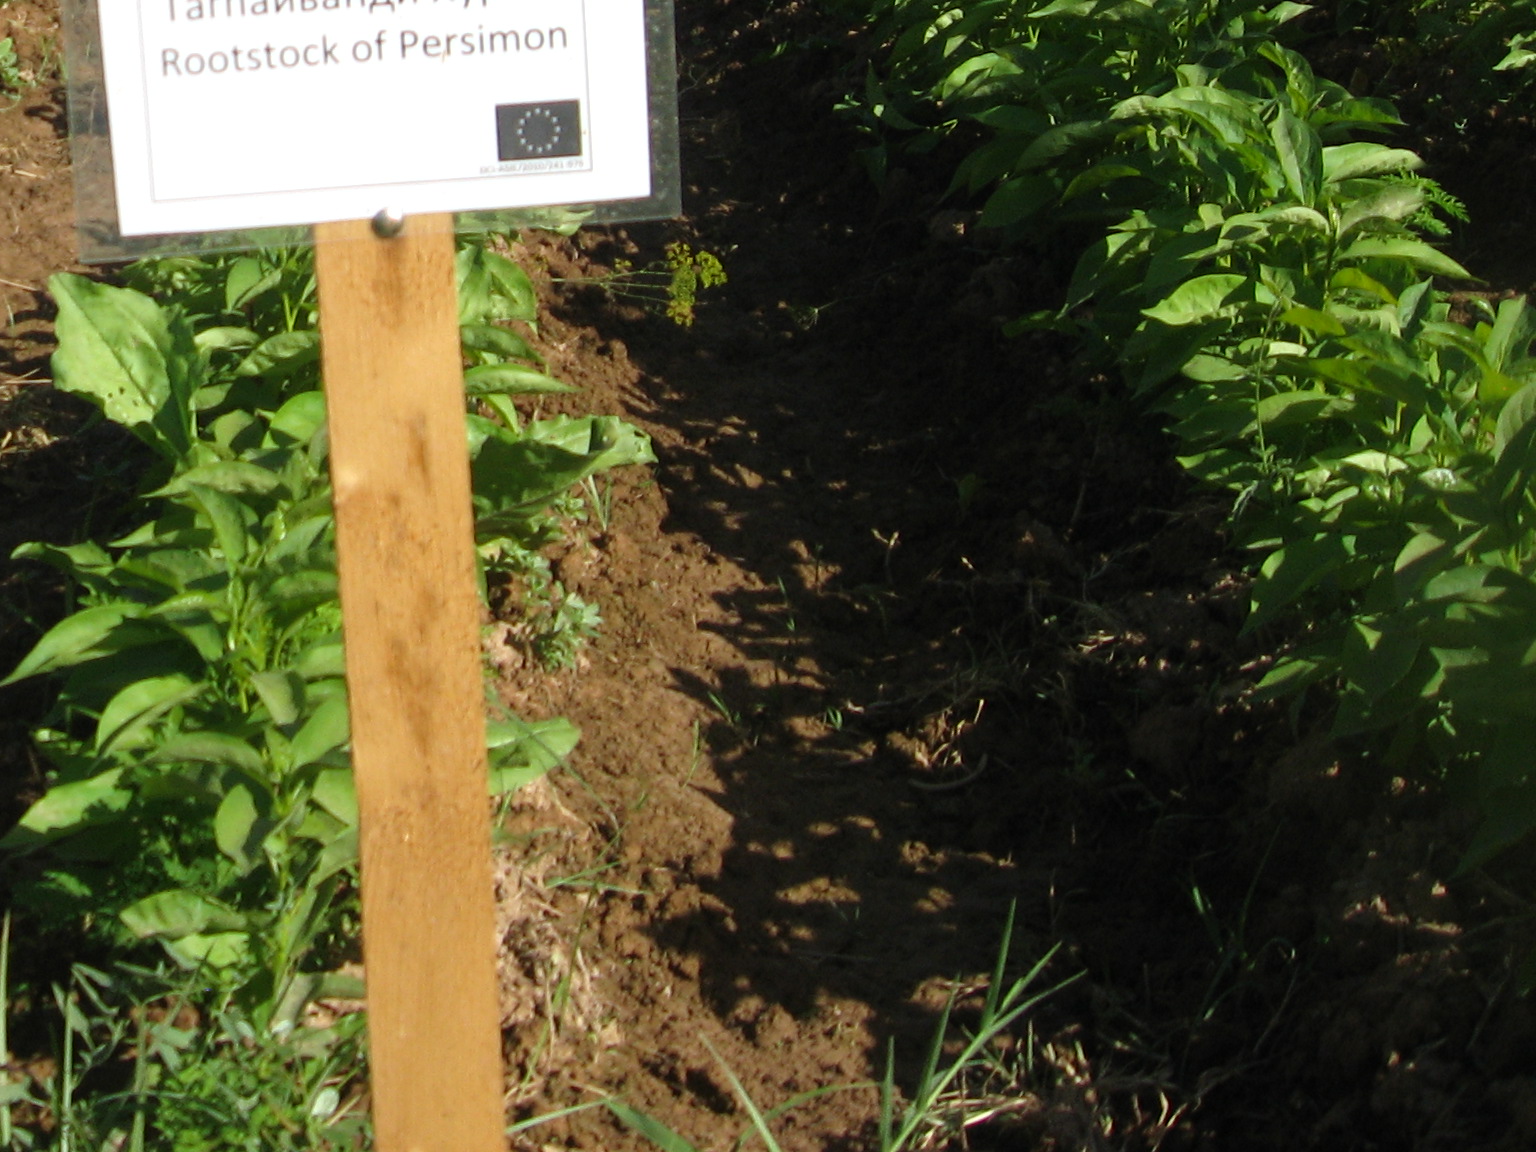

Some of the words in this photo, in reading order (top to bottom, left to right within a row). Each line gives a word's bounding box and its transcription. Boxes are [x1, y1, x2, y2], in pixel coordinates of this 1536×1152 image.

[161, 35, 340, 77] Rootstock
[351, 30, 385, 62] of
[399, 24, 568, 61] Persimon
